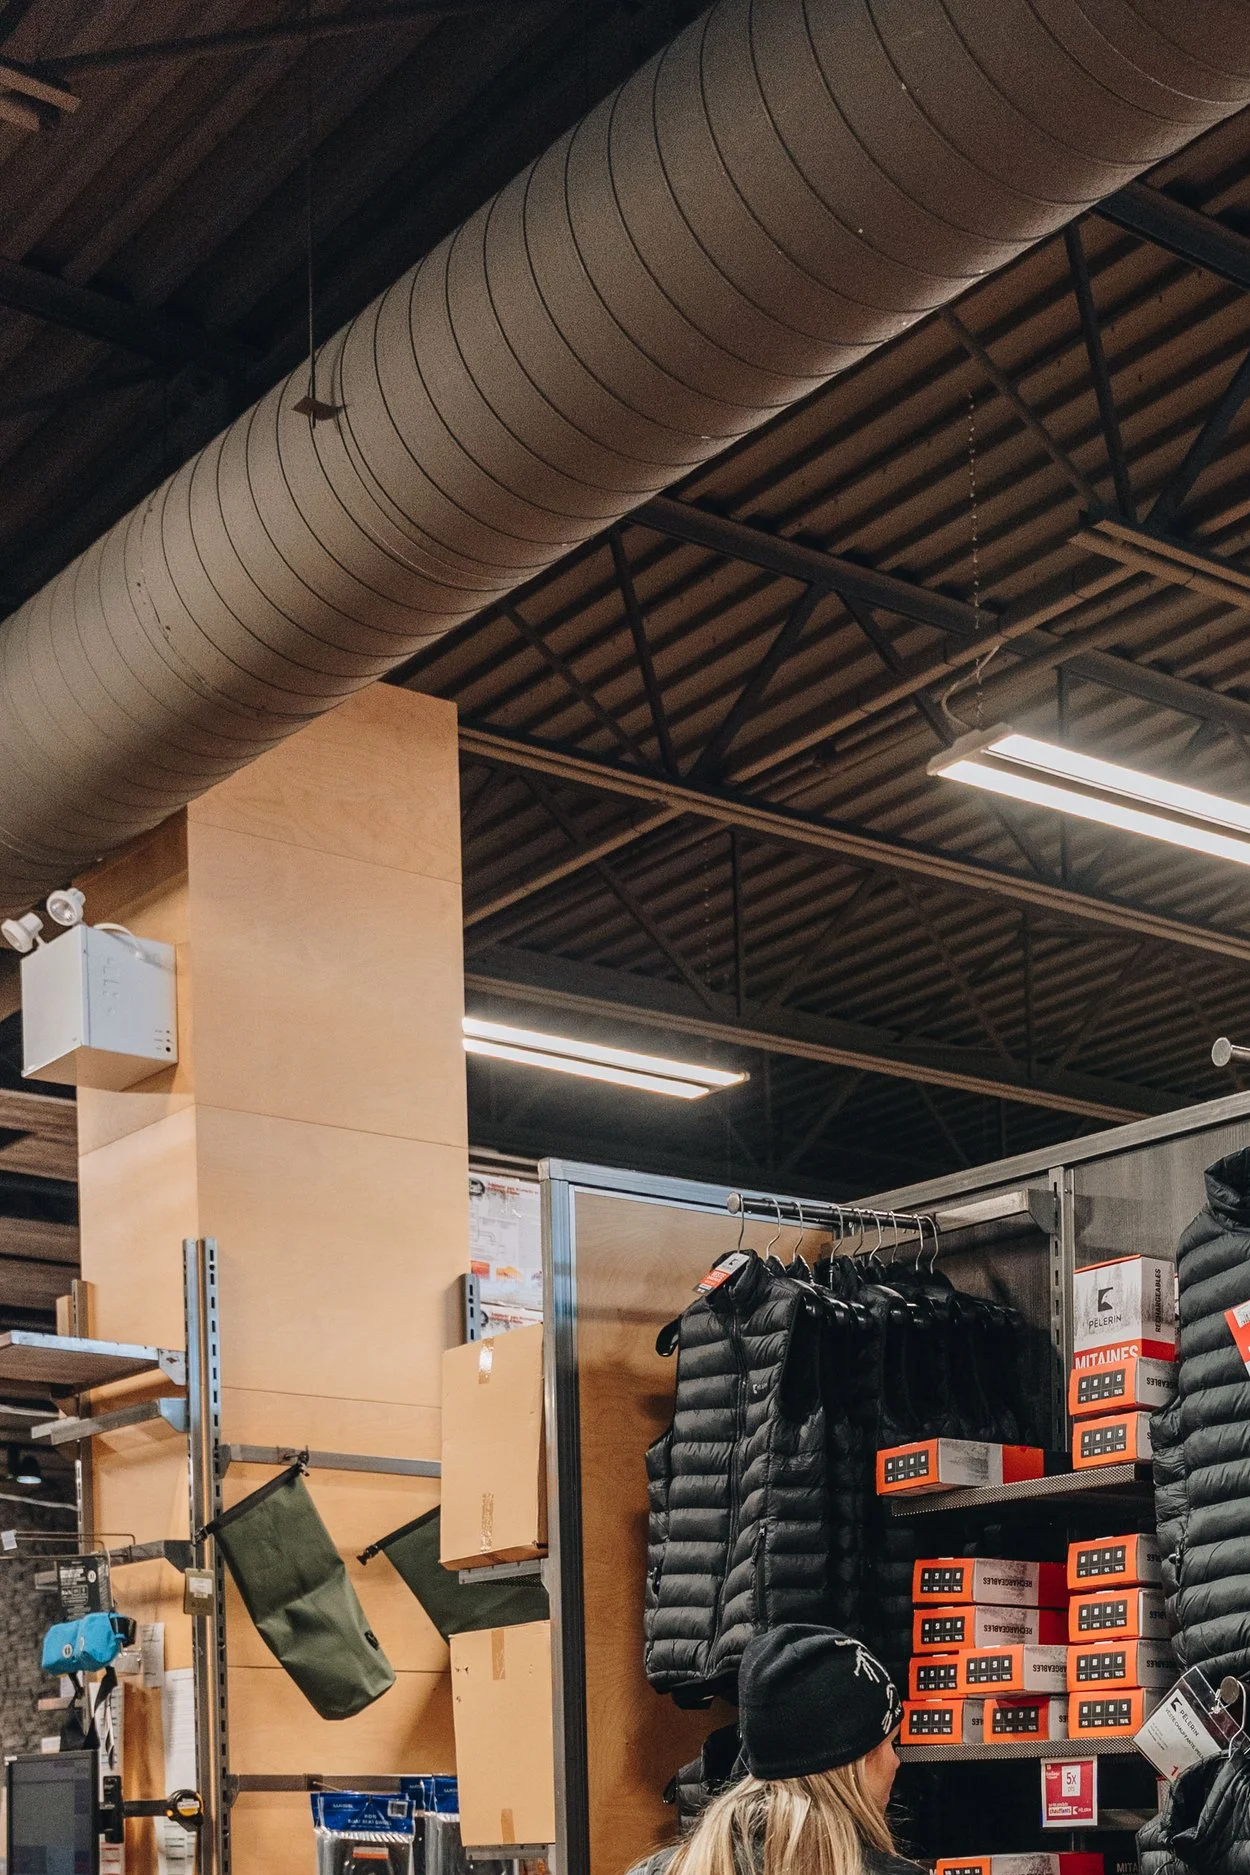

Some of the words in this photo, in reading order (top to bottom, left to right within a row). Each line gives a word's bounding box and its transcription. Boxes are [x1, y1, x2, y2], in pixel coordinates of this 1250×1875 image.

[1076, 1344, 1139, 1370] MITAINES
[983, 1577, 1033, 1588] RECHARGEABLES
[983, 1624, 1033, 1634] RECHARGEABLES
[1066, 1773, 1076, 1785] 5x
[1116, 1862, 1139, 1873] MITA
